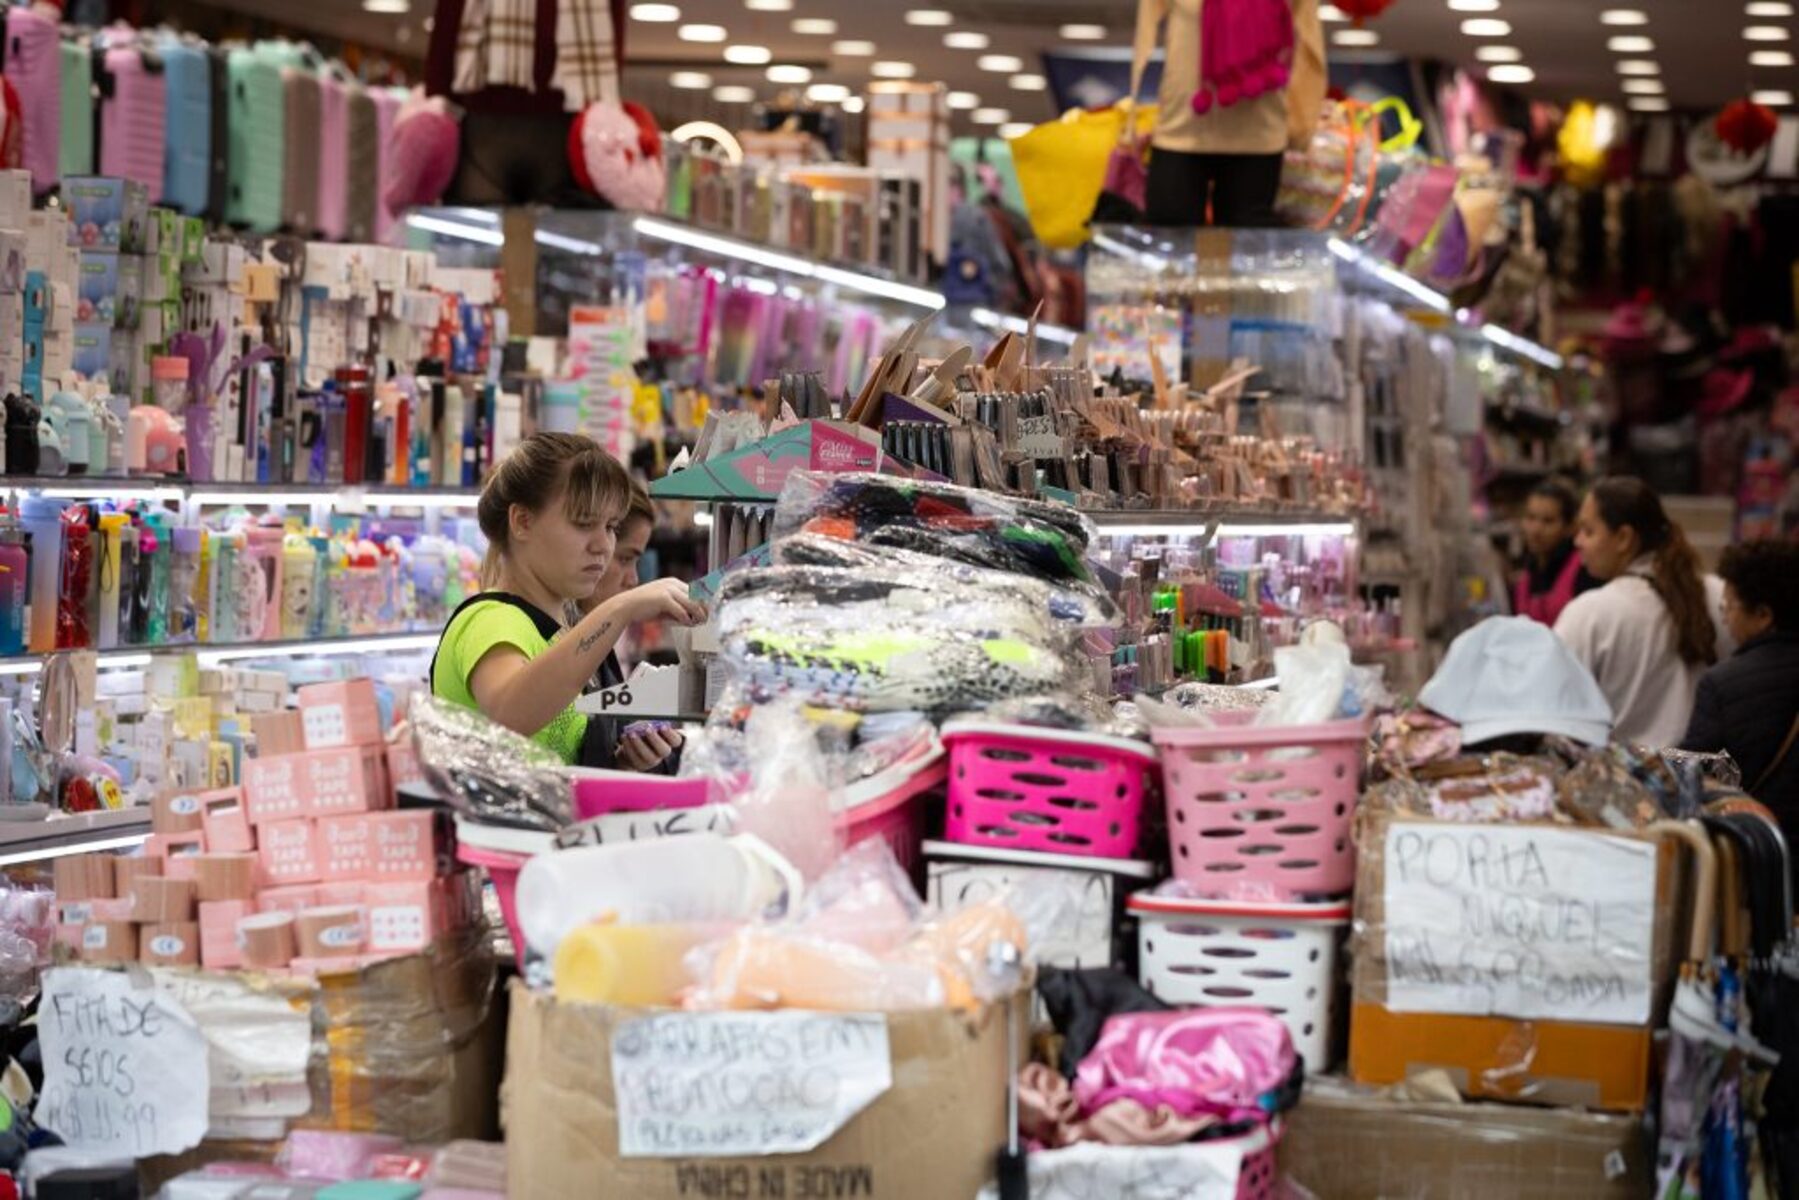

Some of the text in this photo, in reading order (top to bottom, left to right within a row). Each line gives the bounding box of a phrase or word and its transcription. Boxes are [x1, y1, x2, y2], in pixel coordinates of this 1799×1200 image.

[601, 684, 633, 710] pó
[1395, 831, 1549, 889] PORTA
[758, 1165, 786, 1196] IN
[794, 1164, 873, 1196] MADE
